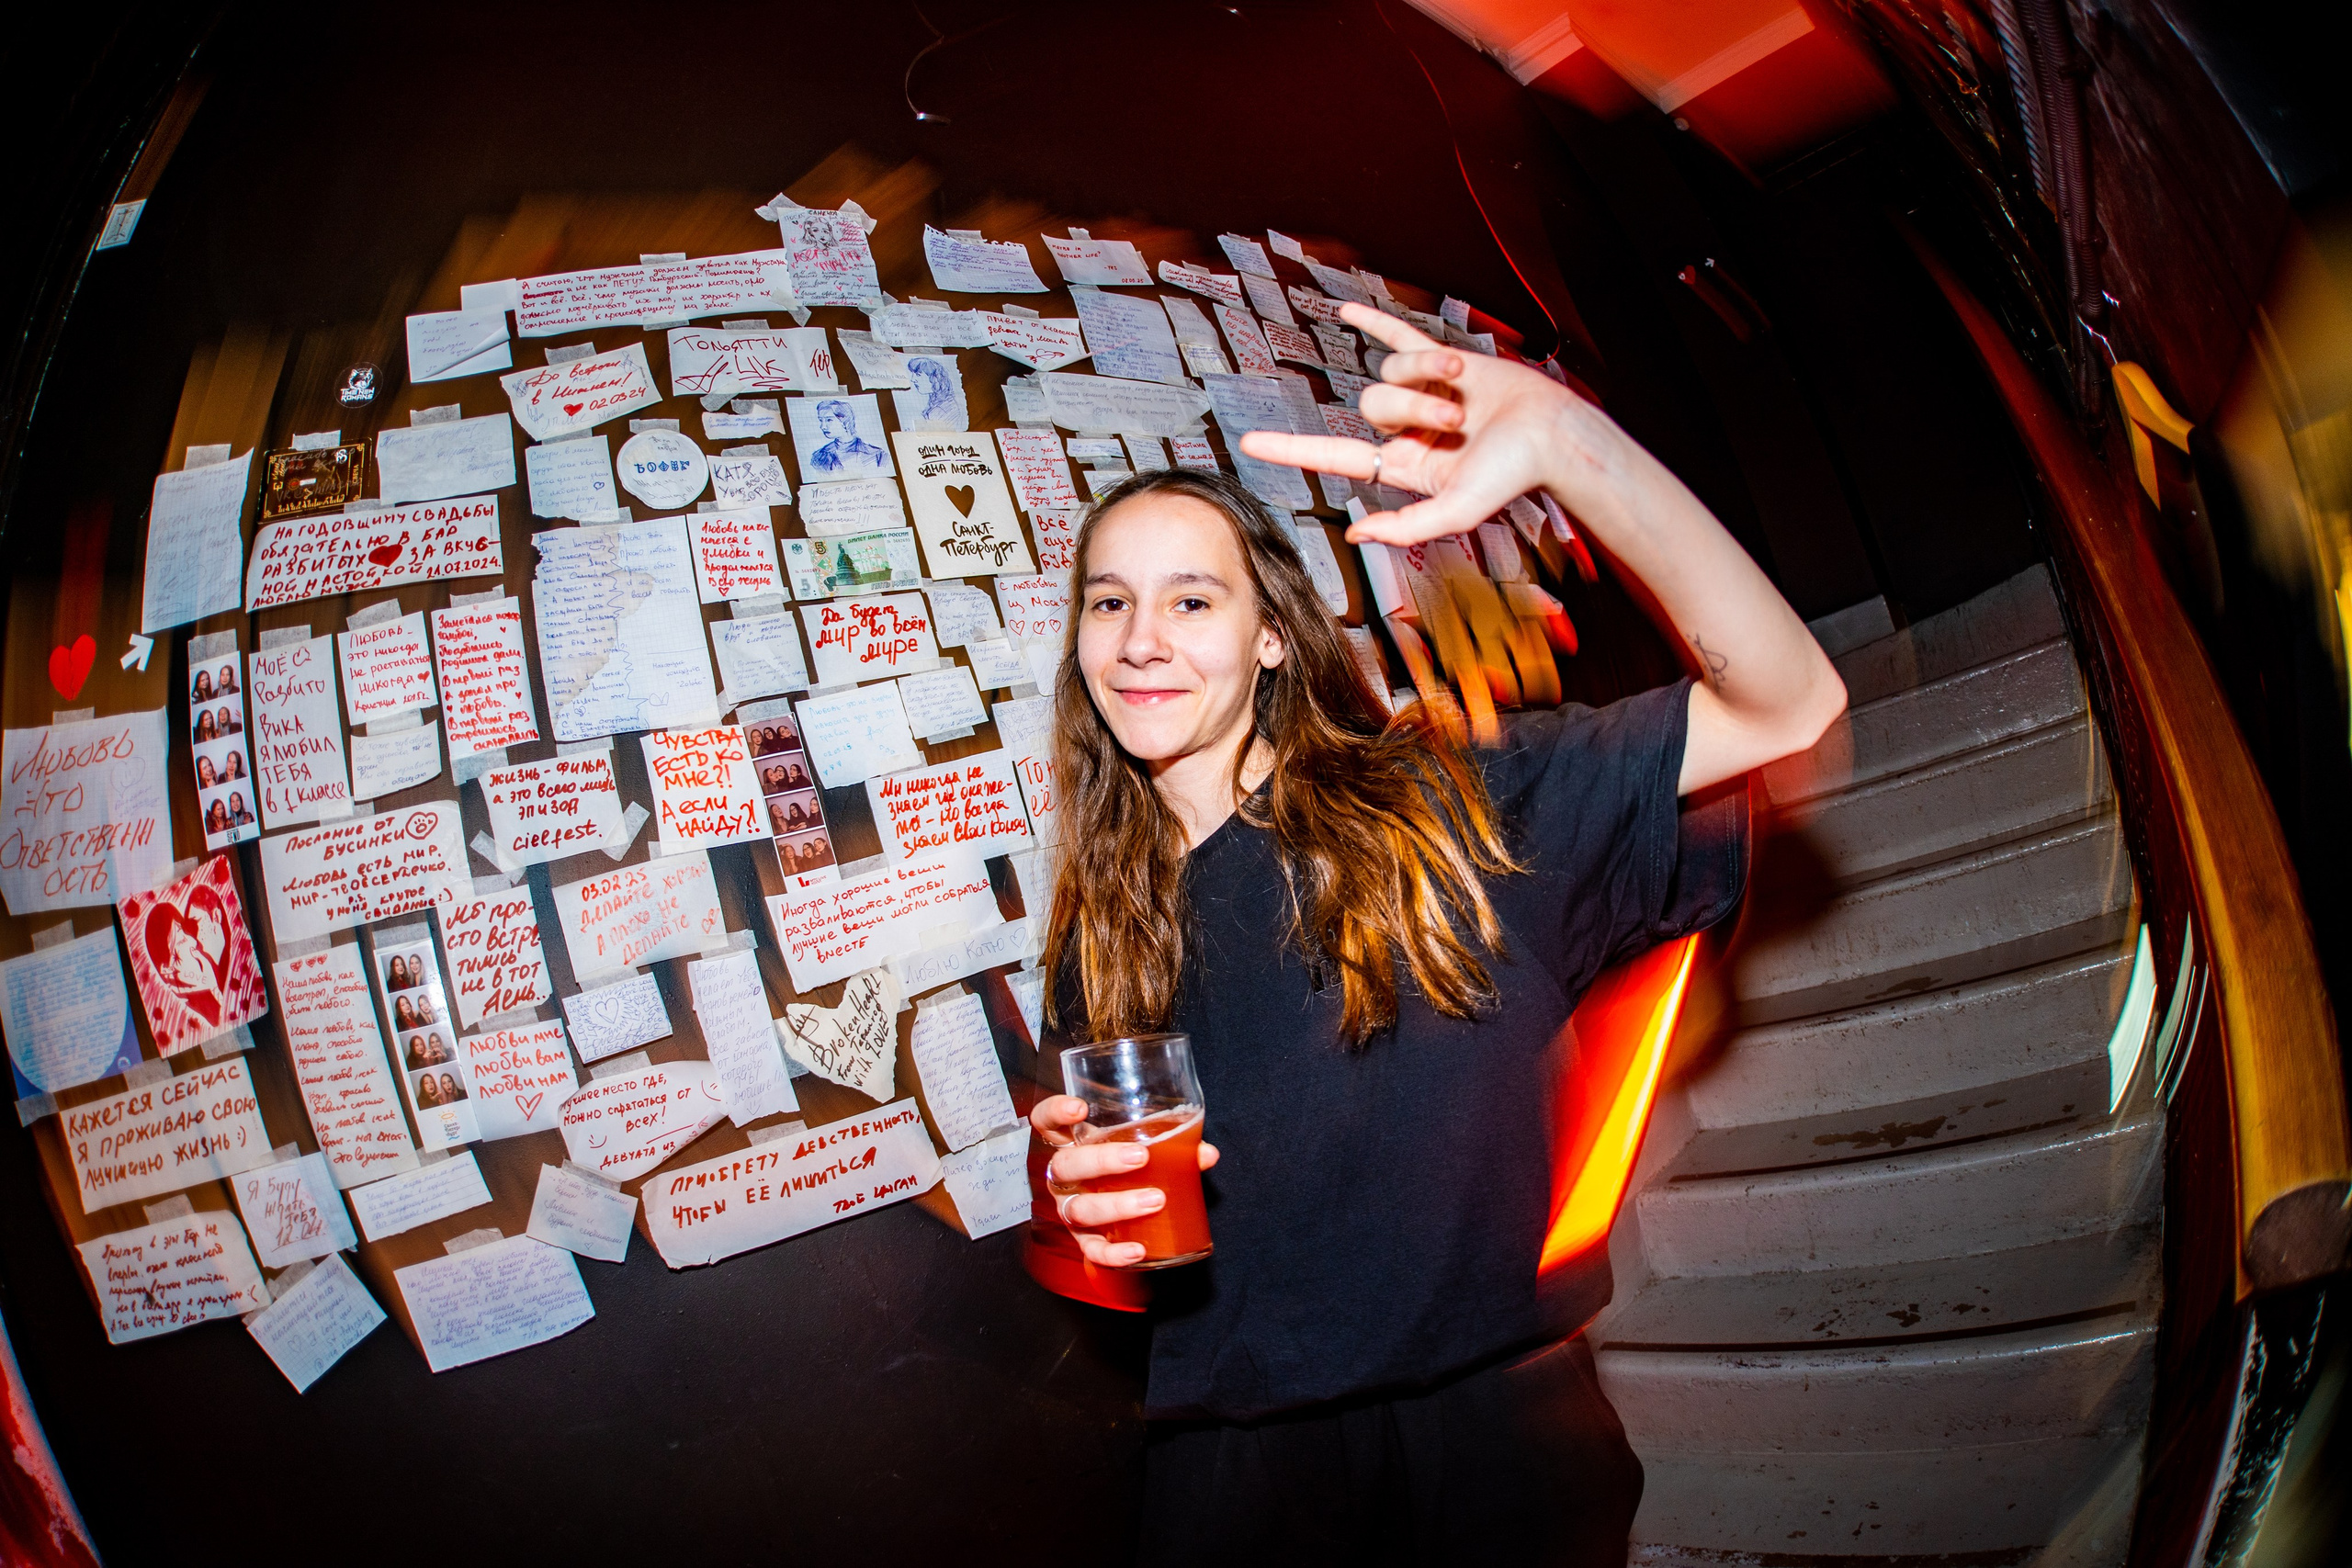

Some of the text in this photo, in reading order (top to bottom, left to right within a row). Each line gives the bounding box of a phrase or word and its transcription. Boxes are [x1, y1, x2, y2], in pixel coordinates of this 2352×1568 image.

[613, 277, 645, 288] ПЕТУХ
[340, 393, 374, 401] ROMANS
[421, 525, 459, 542] БАР
[815, 541, 826, 554] 5
[261, 554, 367, 579] РАЗБИТЫХ
[820, 607, 844, 626] Да
[816, 625, 861, 653] мир
[860, 637, 919, 666] мире
[498, 665, 521, 677] раз
[323, 829, 405, 861] БУСИНКИ
[184, 971, 208, 985] LOVE
[162, 1066, 241, 1105] СЕЙЧАС
[78, 1142, 88, 1164] Я
[211, 1097, 256, 1121] СВОЮ
[670, 1152, 780, 1197] ПРИОБРЕТУ
[672, 1199, 727, 1229] ЧТОБЫ
